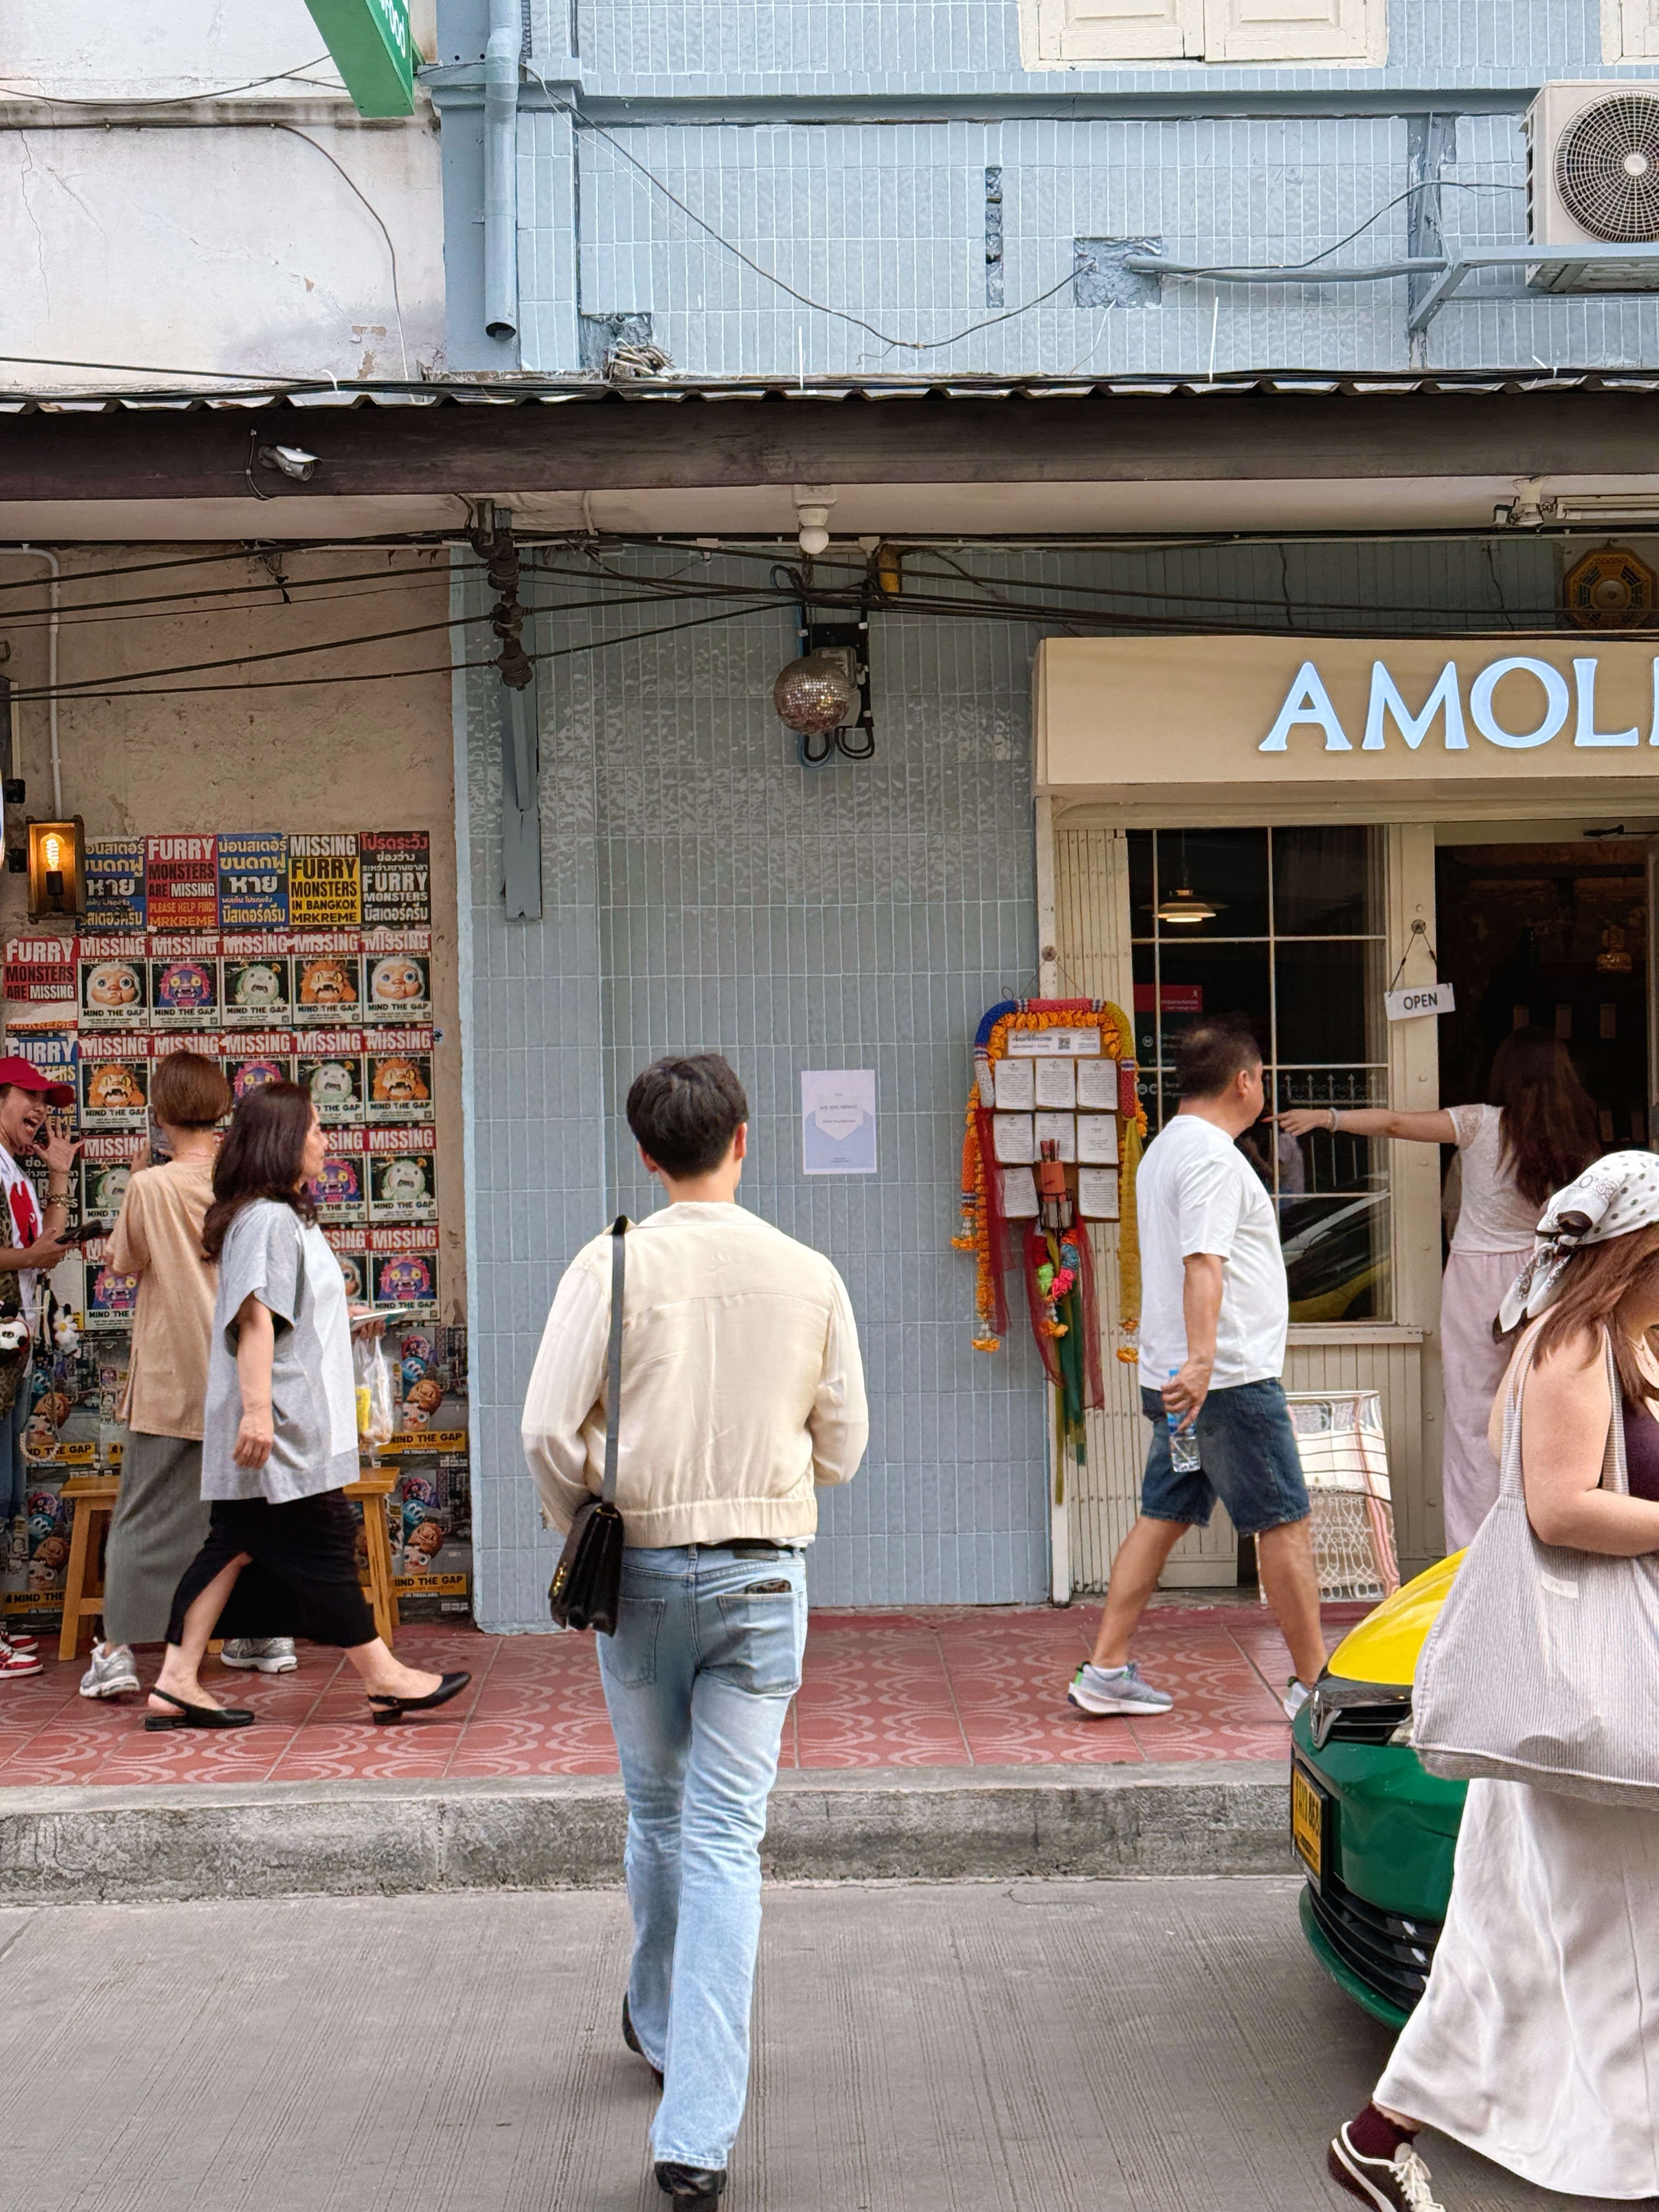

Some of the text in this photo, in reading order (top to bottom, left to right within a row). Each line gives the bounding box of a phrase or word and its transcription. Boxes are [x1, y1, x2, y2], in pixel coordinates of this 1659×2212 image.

[1259, 656, 1659, 751] AMOL
[86, 839, 145, 855] อนสเตอร์
[148, 838, 215, 860] FURRY
[290, 836, 356, 857] MISSING
[361, 833, 428, 850] โปรดระวัง
[219, 853, 286, 874] ขนดกฟู
[376, 851, 415, 861] ช่องว่าง
[148, 863, 215, 880] MONSTERS
[291, 858, 357, 879] FURRY
[86, 879, 135, 896] หาย
[149, 882, 215, 898] ARE MISSING
[229, 876, 278, 893] หาย
[291, 881, 357, 898] MONSTERS
[362, 872, 427, 892] FURRY
[292, 899, 357, 910] IN BANGKOK
[363, 892, 428, 902] MONSTERS
[149, 902, 176, 913] PLEASE
[178, 901, 195, 913] HELP
[150, 915, 215, 927] MRKREME
[291, 912, 357, 923] MRKREME
[80, 937, 145, 956] MISSING
[152, 936, 217, 956] MISSING
[223, 934, 287, 954] MISSING
[294, 934, 359, 953] MISSING
[365, 932, 429, 951] MISSING
[6, 939, 74, 963] FURRY
[5, 966, 74, 982] MONSTERS
[7, 985, 74, 999] ARE MISSING
[1403, 992, 1437, 1010] OPEN
[82, 1037, 147, 1056] MISSING
[226, 1034, 290, 1053] MISSING
[297, 1032, 360, 1052] MISSING
[366, 1031, 431, 1050] MISSING
[328, 1131, 363, 1150] SING
[369, 1129, 433, 1149] MISSING
[330, 1230, 365, 1249] SING
[373, 1229, 436, 1248] MISSING
[441, 1432, 461, 1441] GAP
[69, 1444, 91, 1453] GAP
[1328, 1497, 1364, 1505] STORE
[418, 1577, 437, 1585] THE
[442, 1576, 462, 1584] GAP
[14, 1593, 64, 1602] MIND THE
